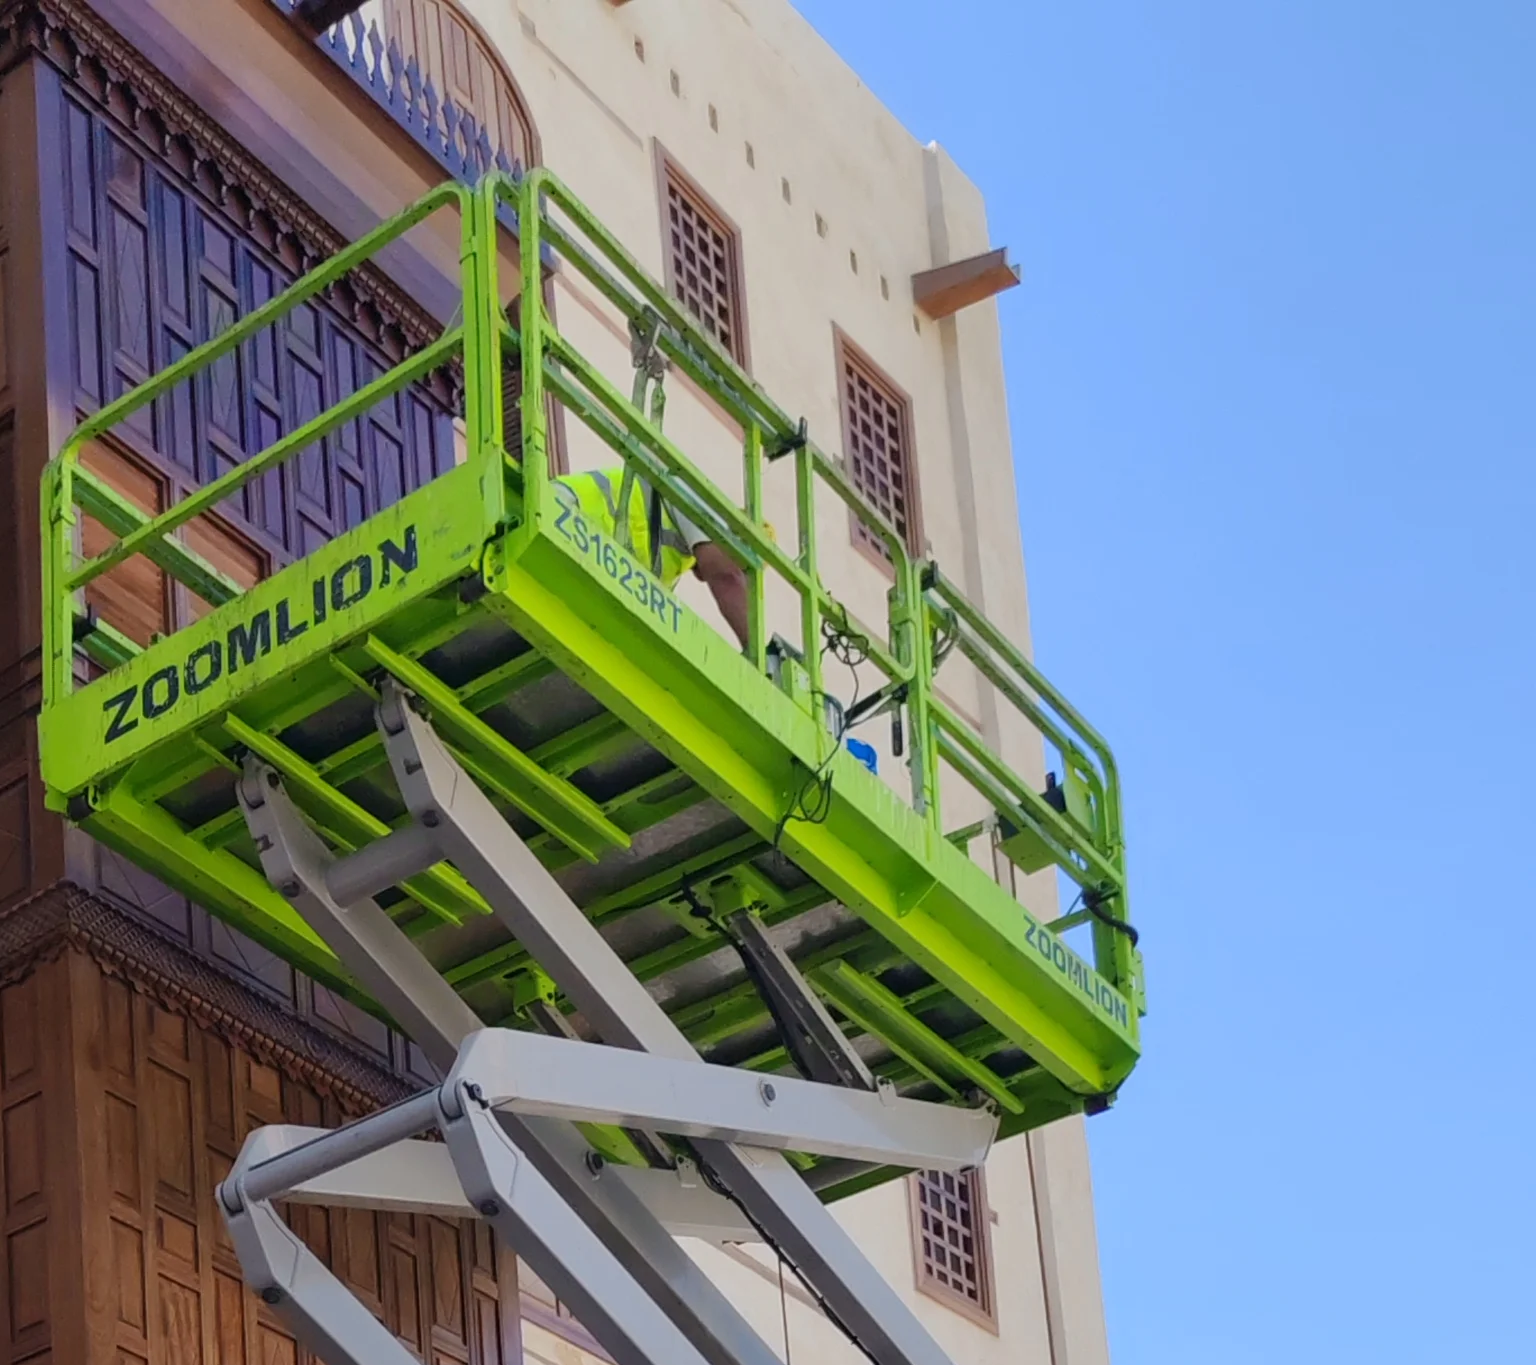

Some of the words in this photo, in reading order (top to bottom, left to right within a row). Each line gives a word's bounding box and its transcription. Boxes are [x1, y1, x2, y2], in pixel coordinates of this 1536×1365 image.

[102, 523, 419, 744] ZOOMLION
[553, 498, 683, 635] ZS1623RT
[1023, 914, 1128, 1029] ZOOMLION
